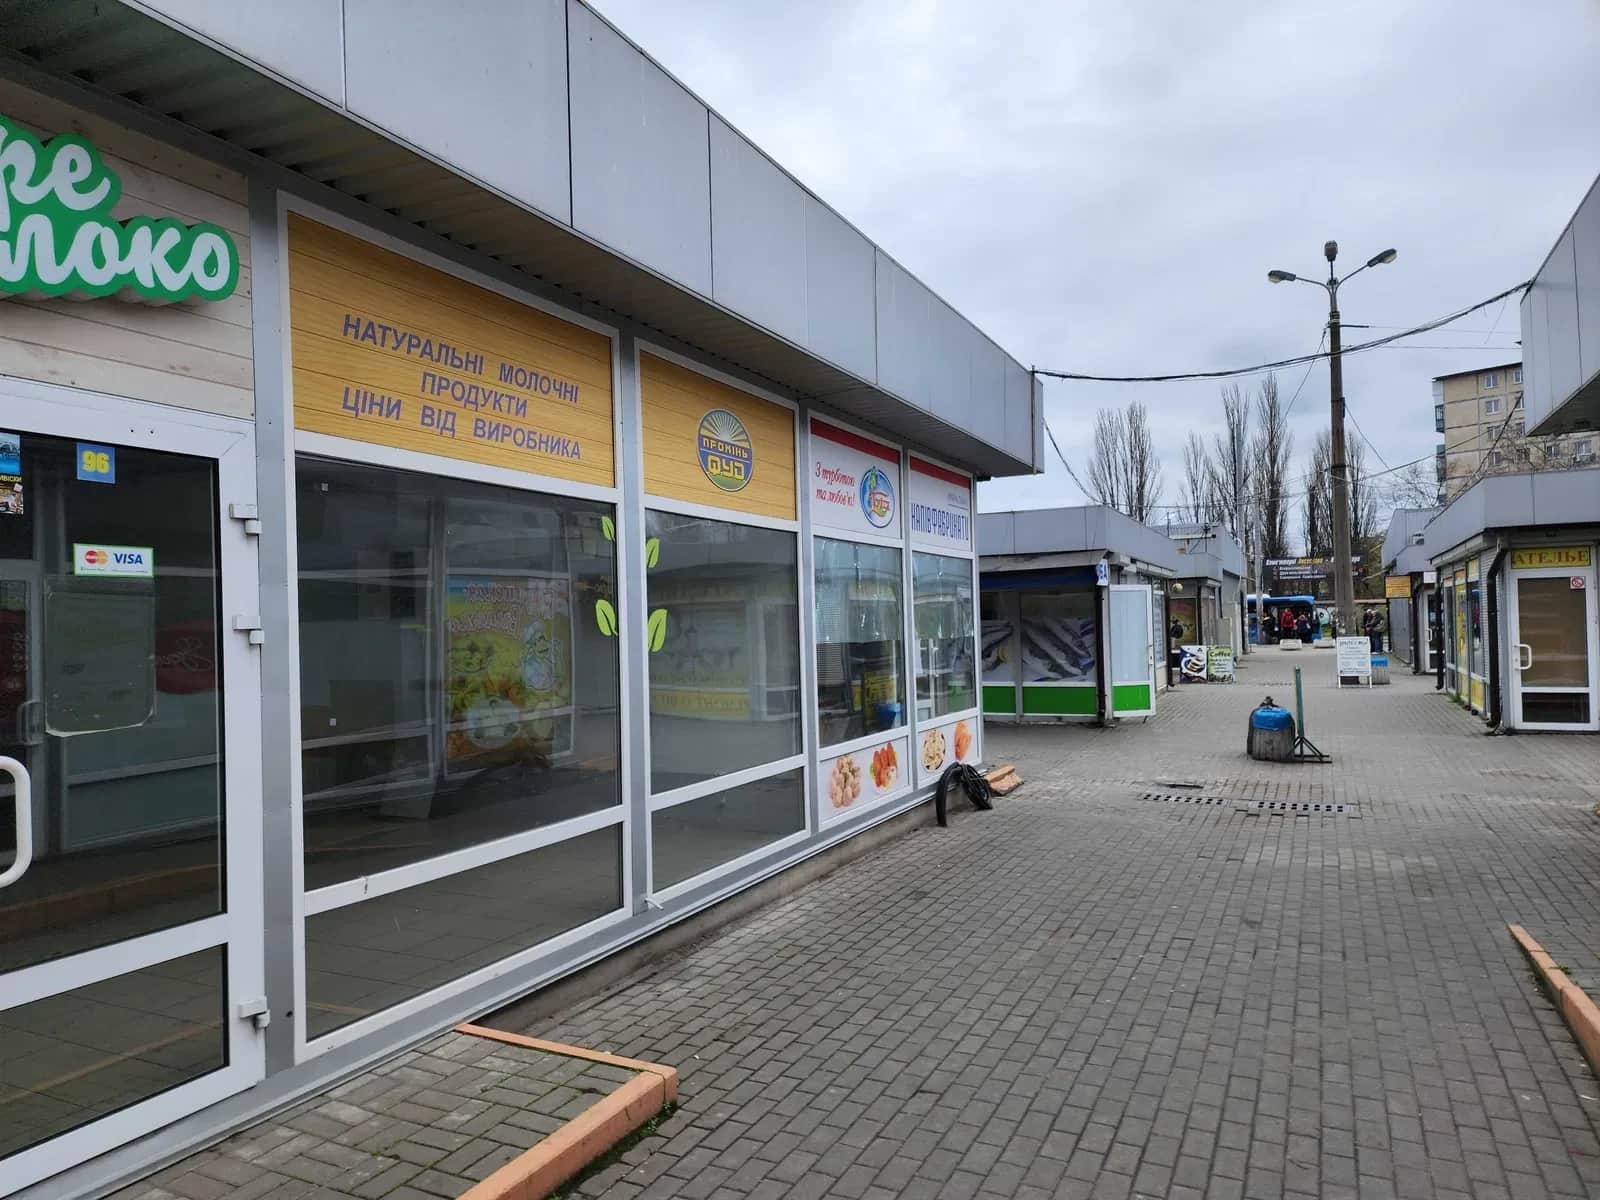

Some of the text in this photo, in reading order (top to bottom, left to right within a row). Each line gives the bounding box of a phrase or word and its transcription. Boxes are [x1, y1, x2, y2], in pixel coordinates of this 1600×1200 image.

[0, 213, 230, 292] локо
[342, 313, 579, 403] НАТУРАЛЬНІ МОЛОЧНІ
[420, 371, 528, 418] ПРОДУКТИ
[341, 386, 582, 460] ЦІНИ ВІД ВИРОБНИКА
[82, 450, 110, 474] 96
[815, 461, 821, 478] З
[816, 488, 826, 501] та
[113, 552, 144, 565] VISA
[1512, 551, 1589, 565] АТЕЛЬЕ
